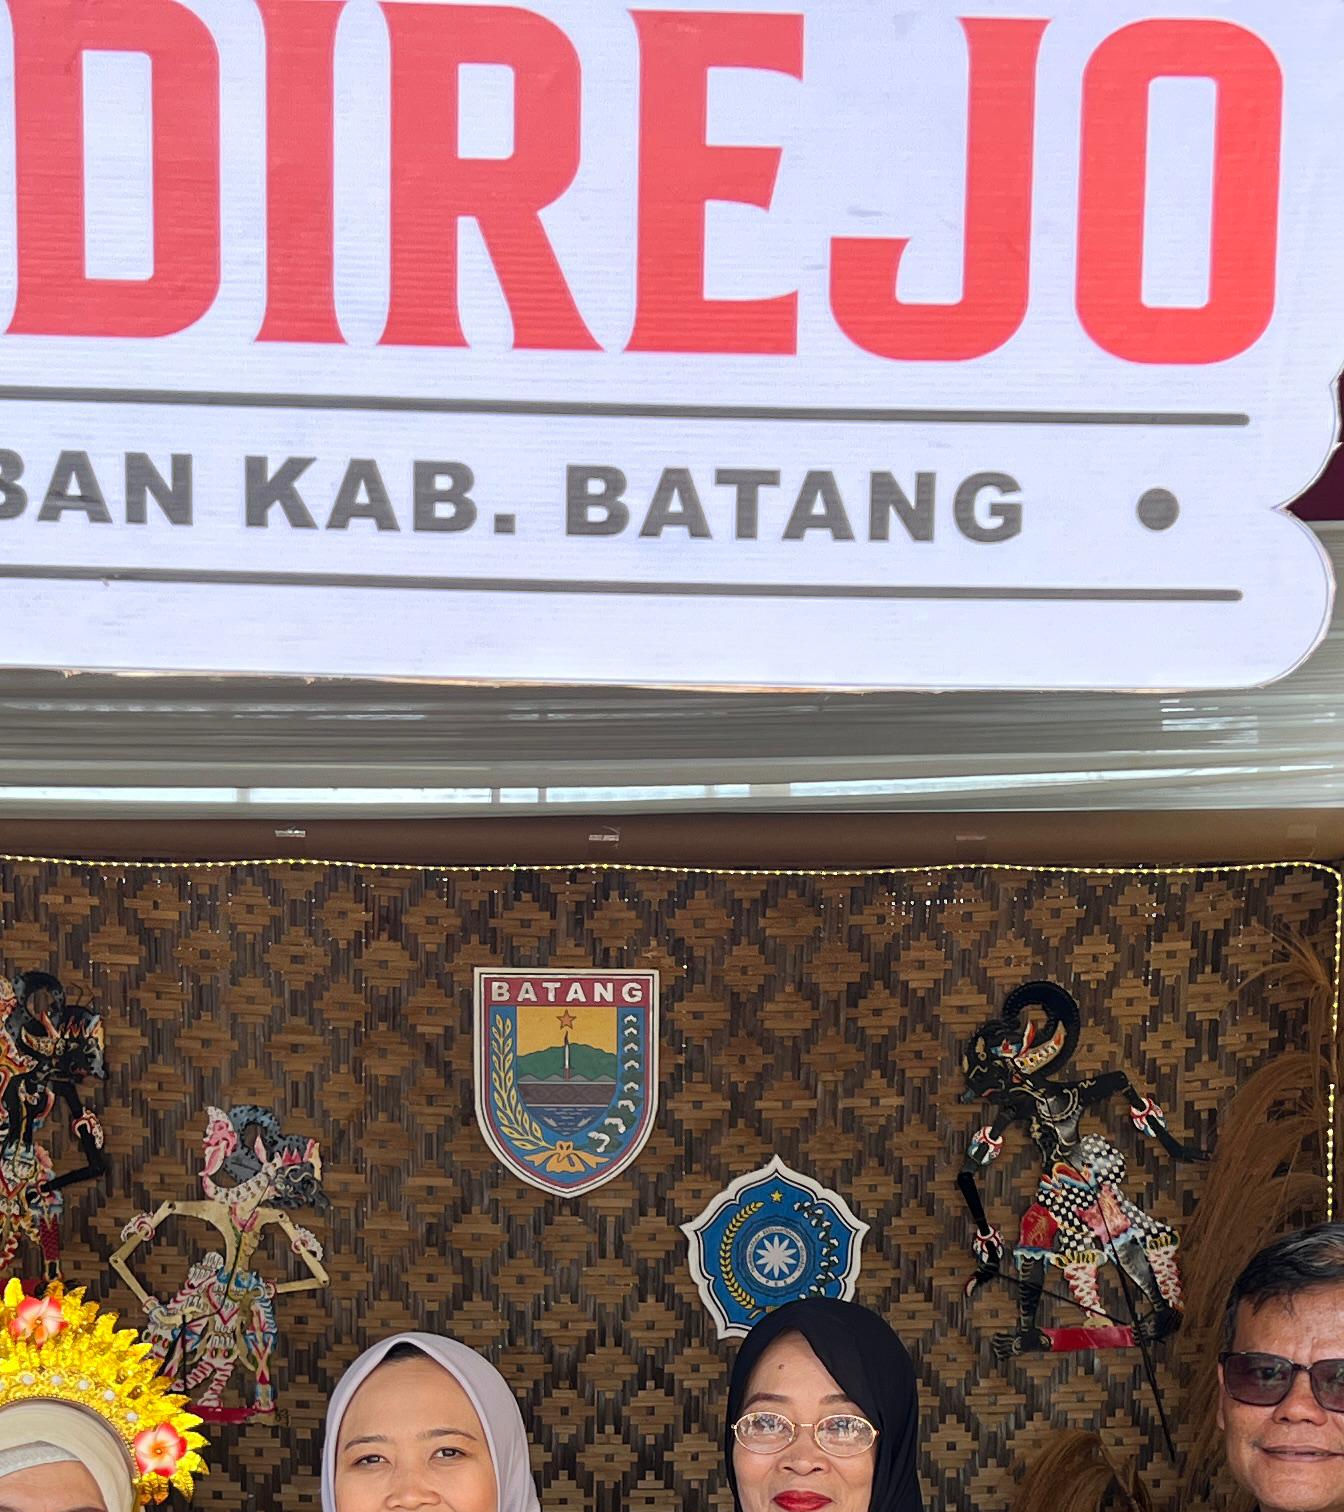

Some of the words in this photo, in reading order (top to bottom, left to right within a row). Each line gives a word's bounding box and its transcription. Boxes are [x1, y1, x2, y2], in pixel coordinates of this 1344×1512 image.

[244, 455, 516, 535] KAB.
[564, 464, 1023, 544] BATANG
[490, 980, 644, 1004] BATANG
